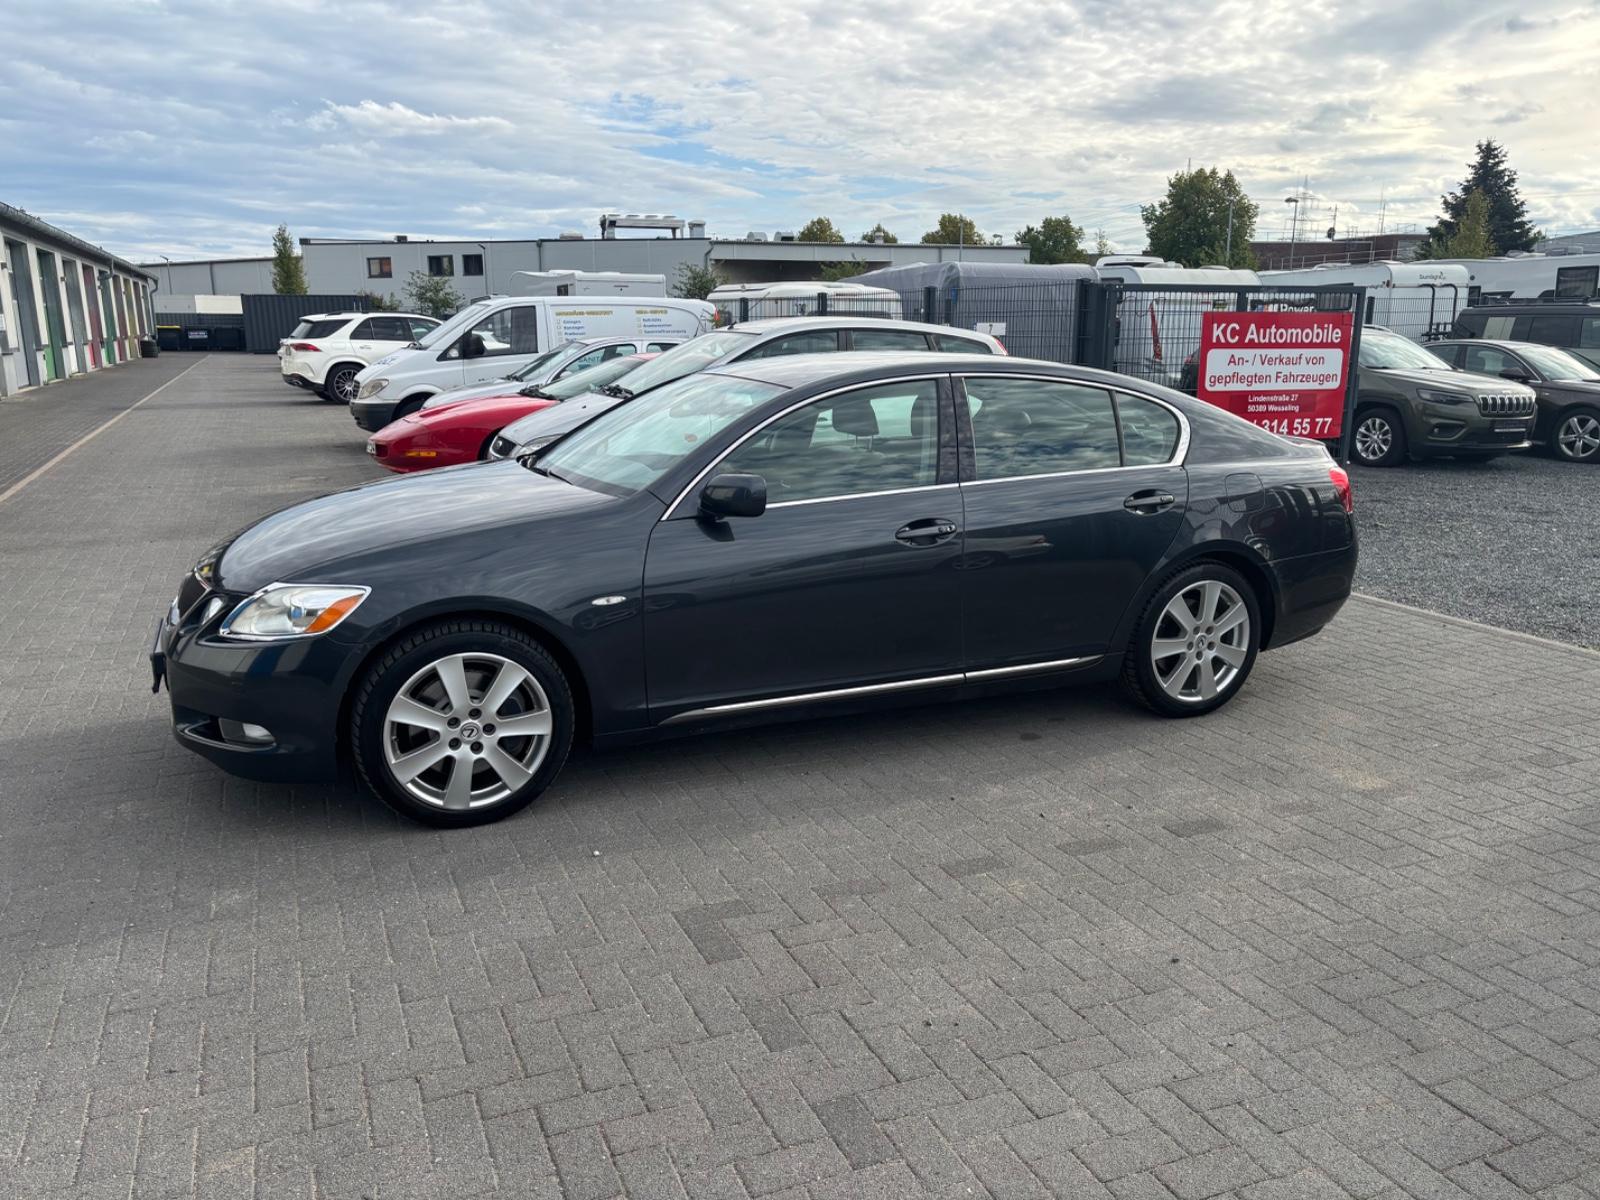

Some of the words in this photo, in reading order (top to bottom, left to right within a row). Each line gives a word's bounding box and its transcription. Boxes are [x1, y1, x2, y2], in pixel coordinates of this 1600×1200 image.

[1212, 322, 1240, 344] KC
[1244, 323, 1342, 344] Automobile
[1227, 354, 1249, 366] An-
[1259, 353, 1303, 366] Verkauf
[1305, 355, 1325, 366] von
[1209, 372, 1272, 387] gepflegten
[1275, 371, 1338, 385] Fahrzeugen
[1248, 394, 1290, 402] Lindenstraße
[1267, 404, 1300, 412] Wesseling
[1261, 418, 1288, 435] 314
[1292, 418, 1310, 435] 55
[1315, 417, 1333, 434] 77
